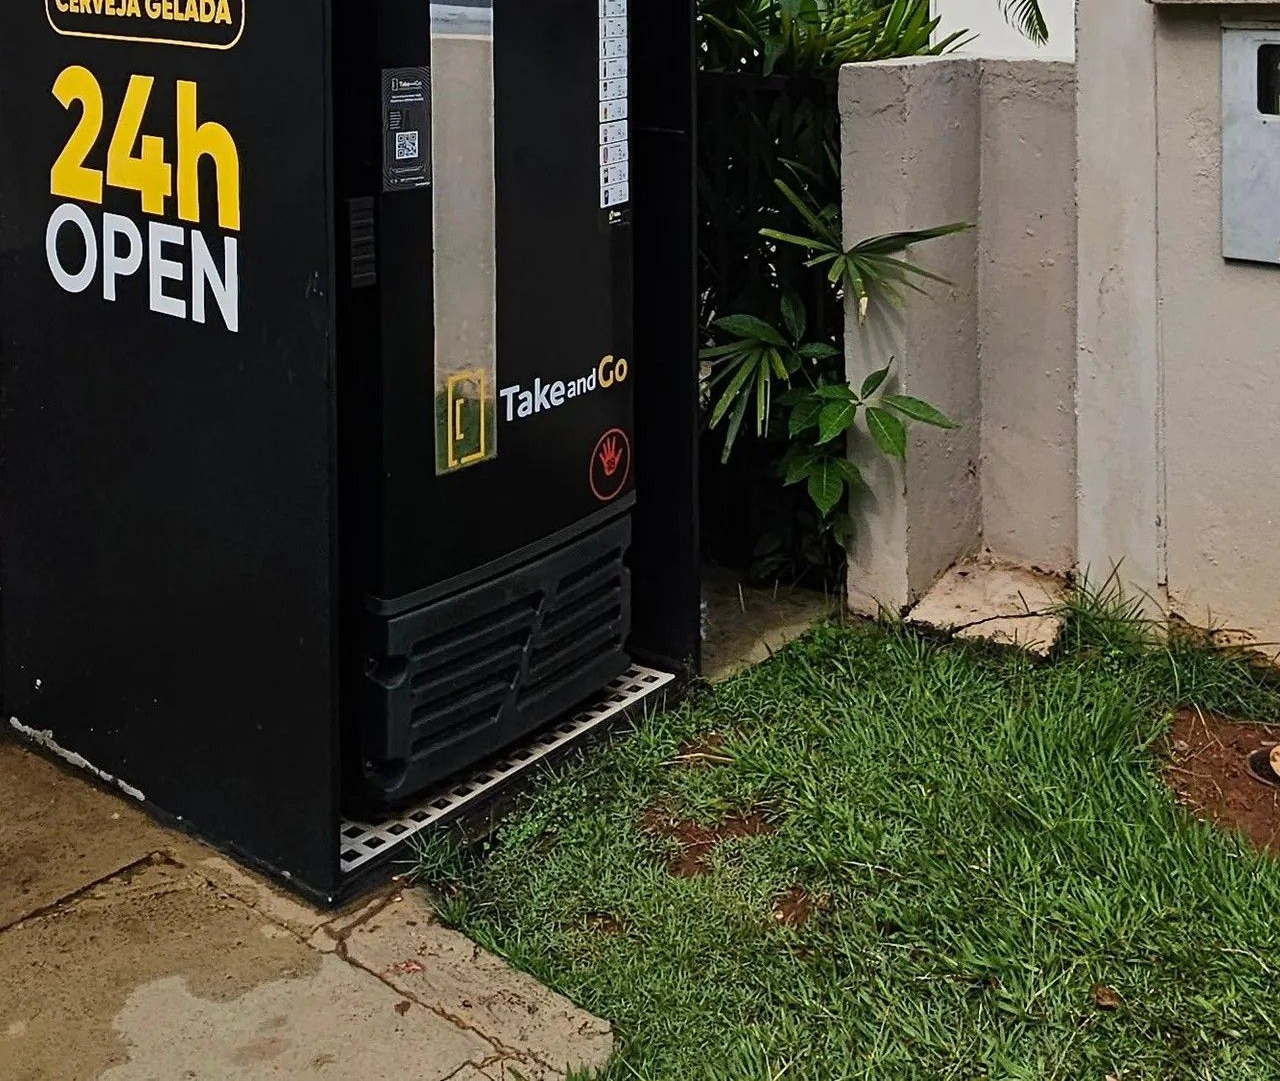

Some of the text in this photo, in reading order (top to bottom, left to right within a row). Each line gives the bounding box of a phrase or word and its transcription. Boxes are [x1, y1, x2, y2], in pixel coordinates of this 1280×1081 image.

[50, 65, 241, 232] 24h
[46, 202, 239, 333] OPEN
[499, 377, 566, 422] Take
[598, 354, 629, 389] Go
